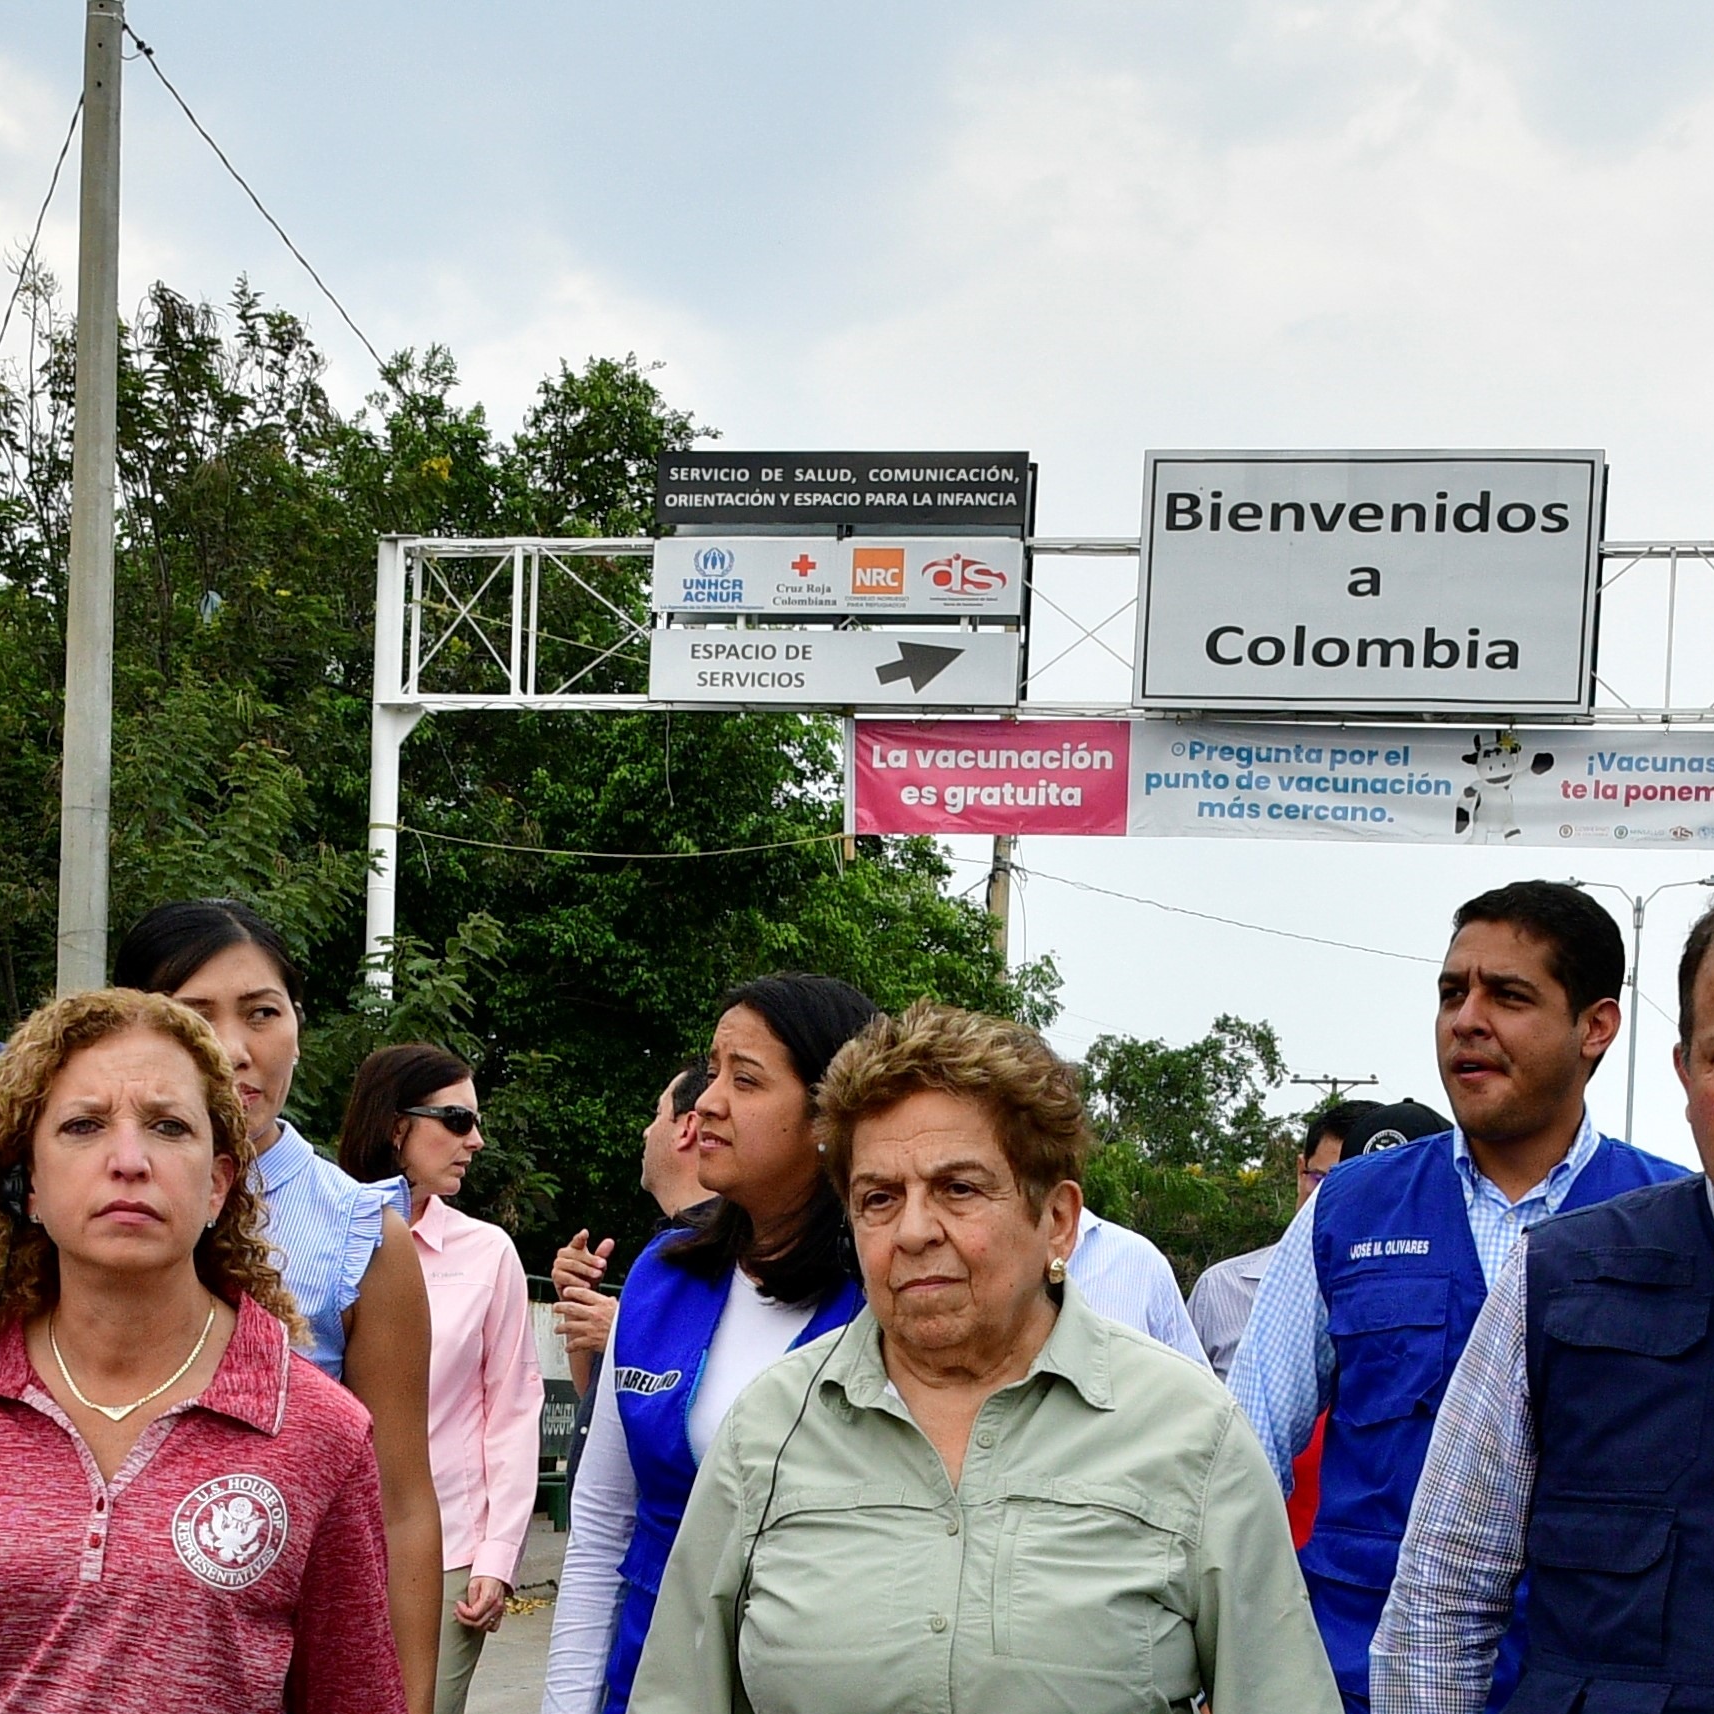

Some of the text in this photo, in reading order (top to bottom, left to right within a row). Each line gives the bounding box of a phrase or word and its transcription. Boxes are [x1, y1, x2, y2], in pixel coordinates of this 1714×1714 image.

[668, 465, 1021, 485] SERVICIO DE SALUD, COMUNICACIÓN,
[664, 488, 1018, 507] ORIENTACIÓN Y ESPACIO PARA LA INFANCIA
[1164, 490, 1570, 534] Bienvenidos
[683, 578, 743, 591] UNHCR
[855, 567, 900, 587] NRC
[1347, 565, 1382, 597] a
[682, 591, 743, 603] ACNUR
[776, 583, 832, 595] Cruz Roja
[772, 596, 838, 607] Colombiana
[690, 643, 813, 661] ESPACIO DE
[1205, 625, 1520, 670] Colombia
[696, 671, 805, 689] SERVICIOS
[872, 741, 1114, 770] La vacunación
[1188, 741, 1410, 771] Pregunta por el
[1145, 769, 1452, 796] punto de vacunación
[1560, 780, 1588, 799] te
[1593, 780, 1618, 800] la
[900, 779, 1082, 813] es gratuita
[1197, 796, 1395, 823] más cercano.
[1384, 1239, 1430, 1256] OLIVARES
[194, 1478, 283, 1529] U.S. HOUSE OF
[177, 1521, 275, 1586] REPRESENTATIVES
